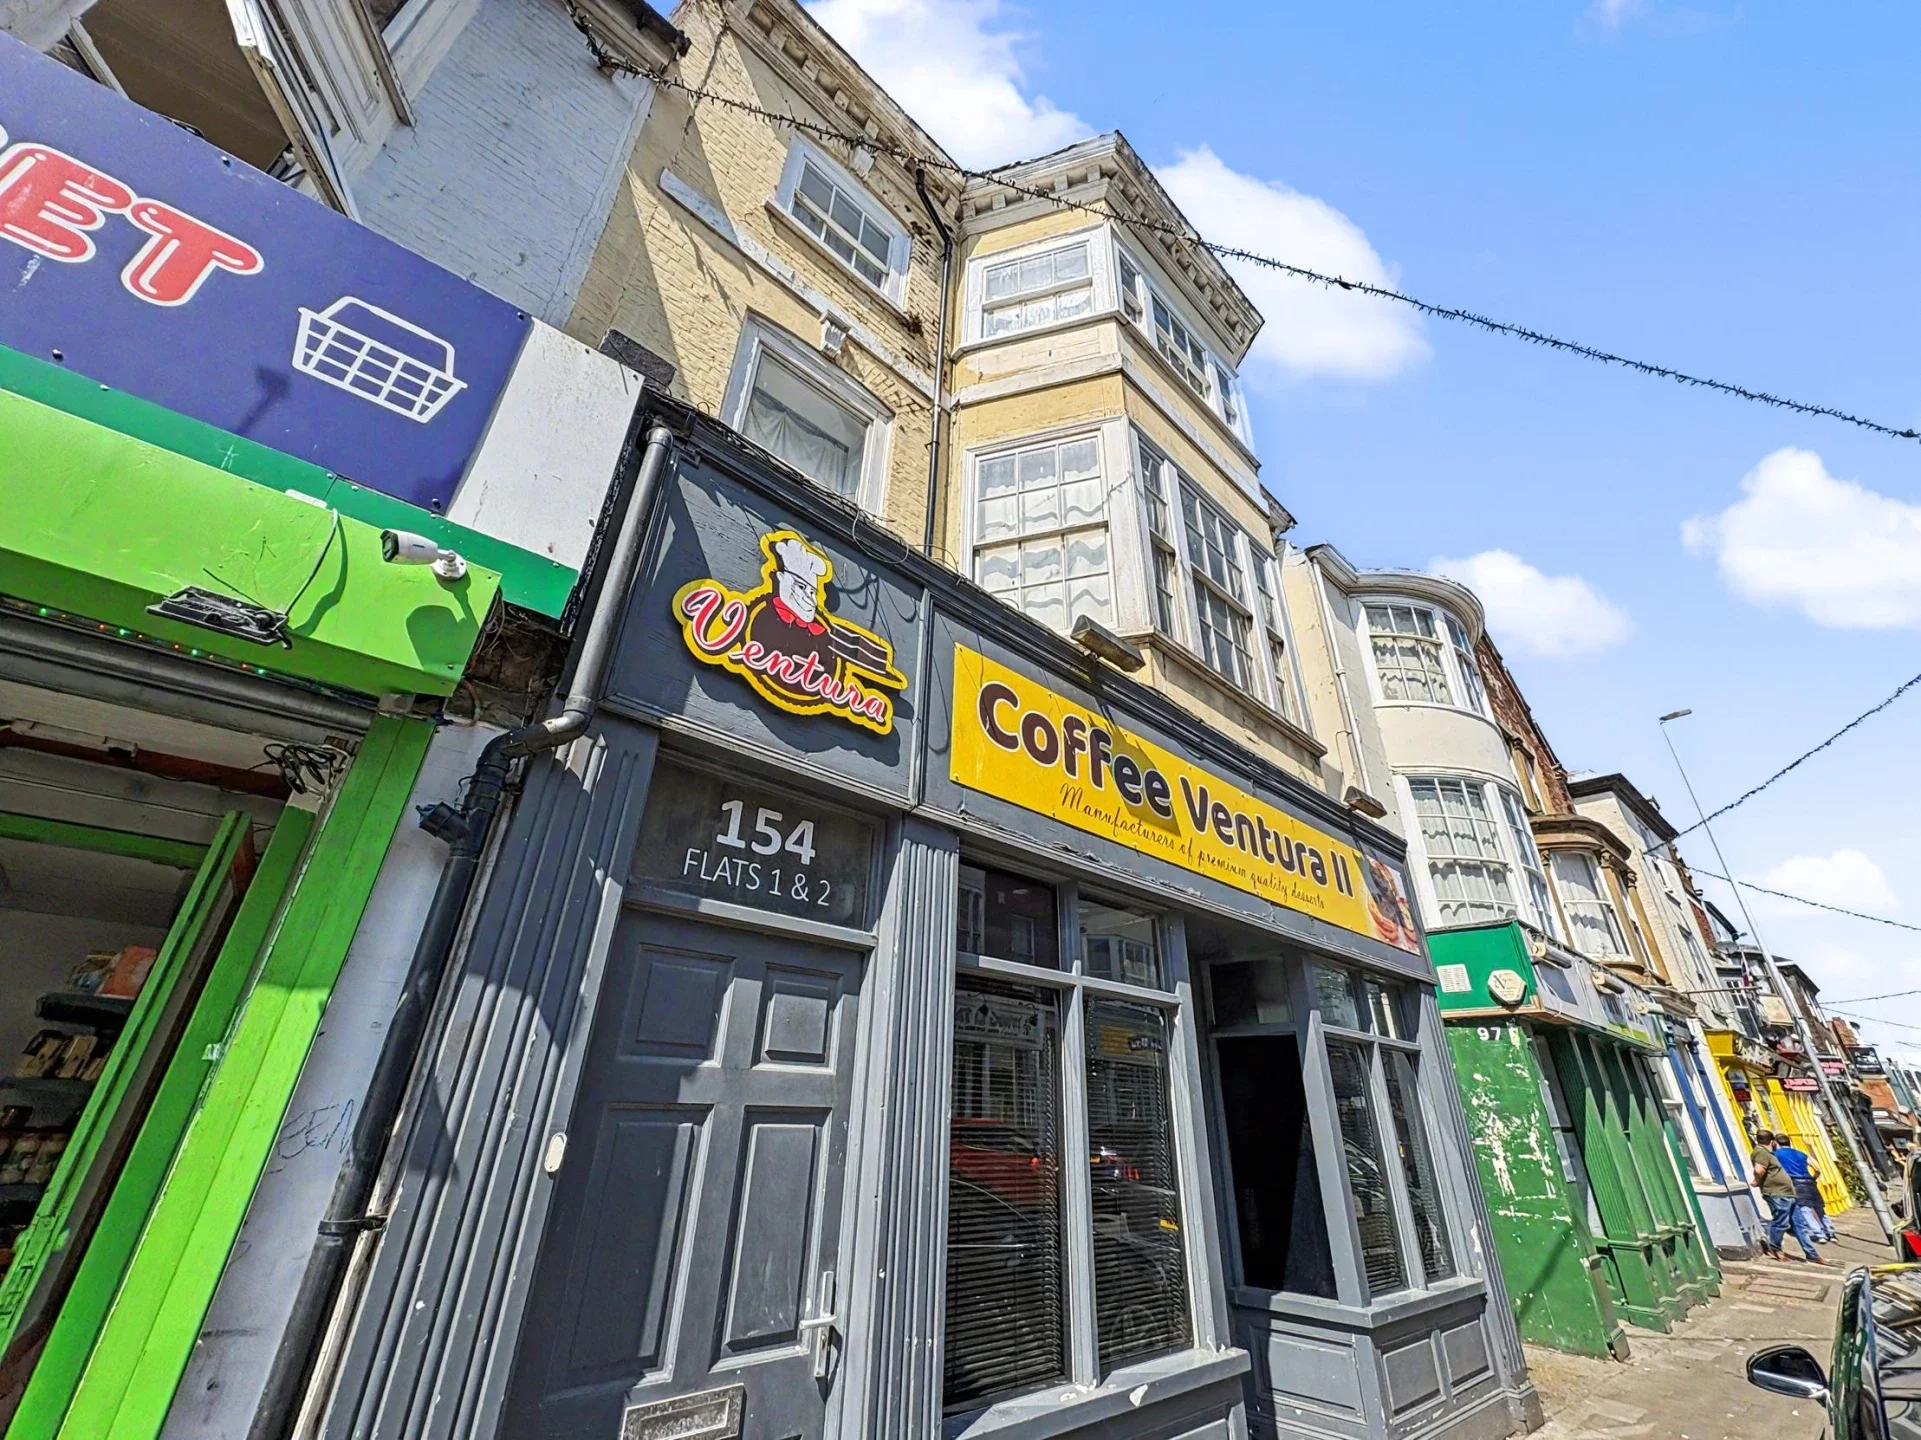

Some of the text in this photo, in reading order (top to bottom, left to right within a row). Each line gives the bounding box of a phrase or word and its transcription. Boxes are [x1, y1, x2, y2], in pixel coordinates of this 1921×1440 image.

[0, 122, 265, 306] ET
[682, 586, 886, 723] Ventura
[716, 799, 816, 866] 154
[977, 681, 1174, 820] Coffee
[1178, 775, 1327, 885] Ventura
[1060, 782, 1326, 909] Manufacturers of premium quality desserts
[683, 847, 832, 906] FLATS 1 & 2
[1477, 1026, 1502, 1042] 97
